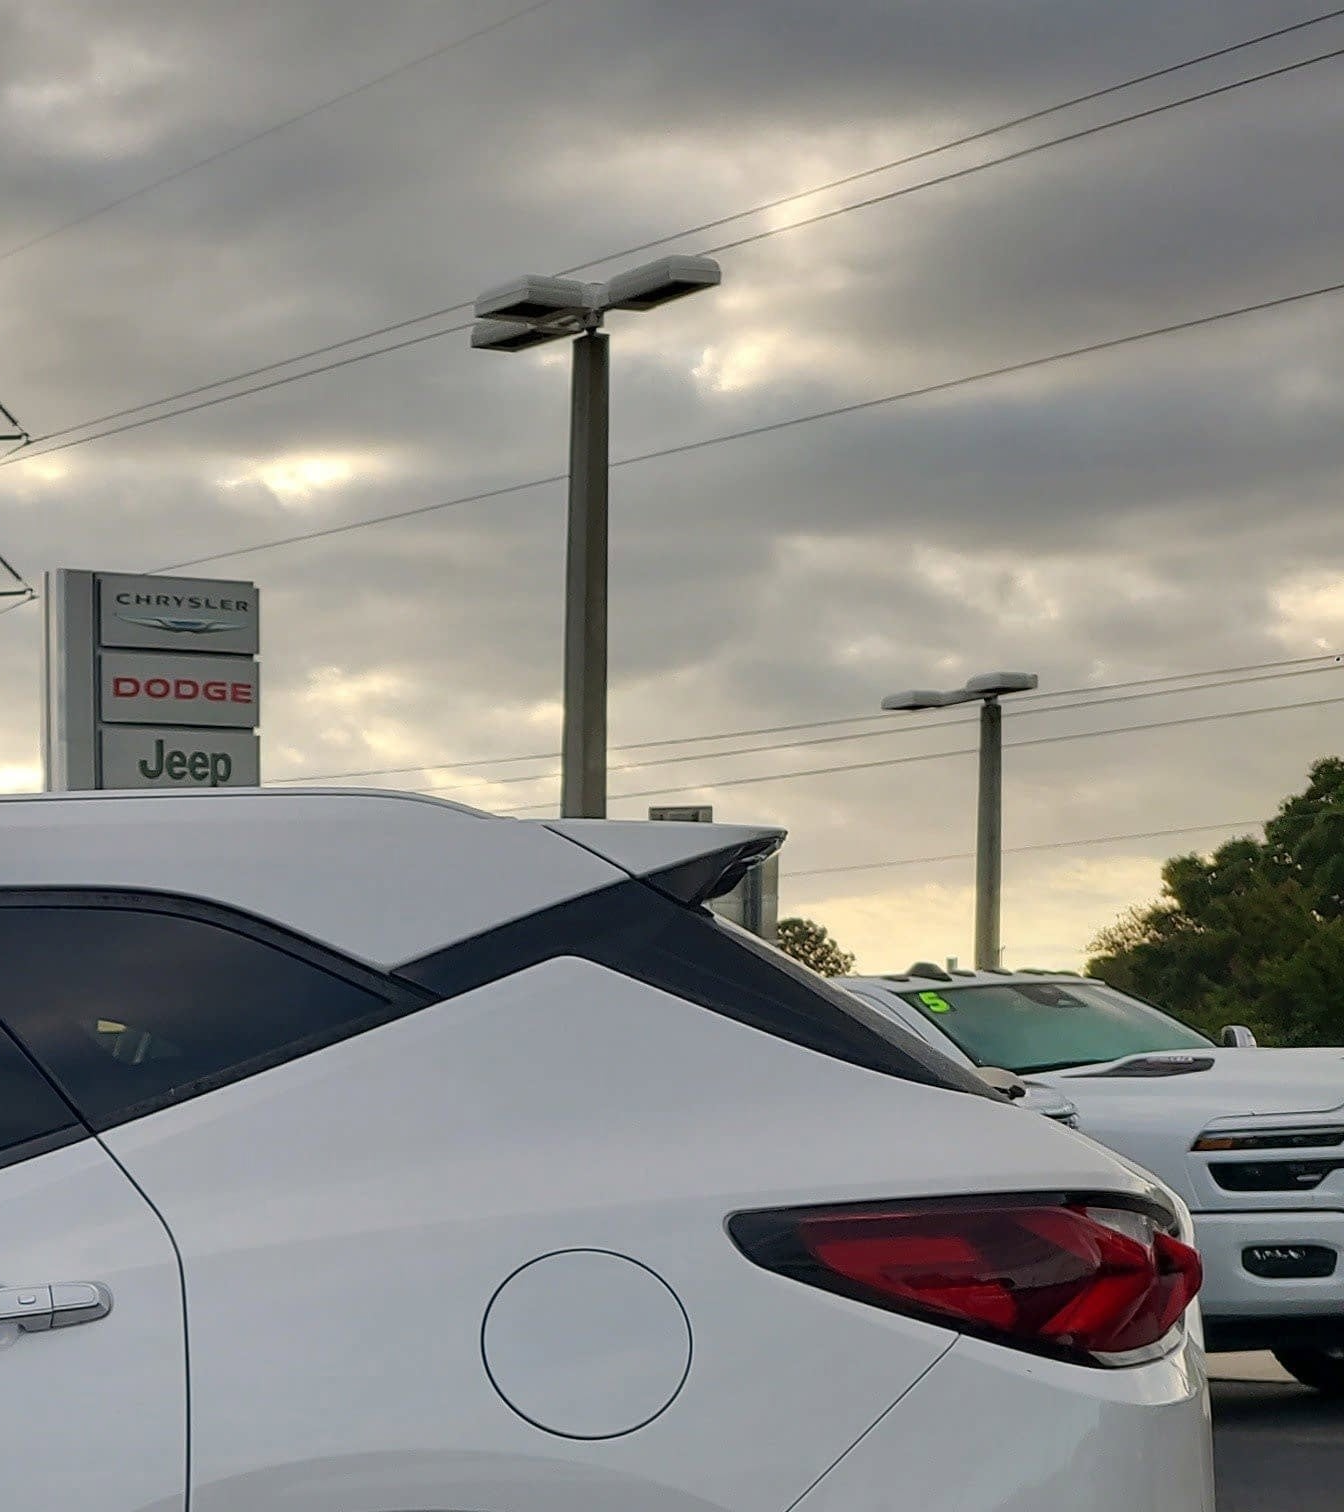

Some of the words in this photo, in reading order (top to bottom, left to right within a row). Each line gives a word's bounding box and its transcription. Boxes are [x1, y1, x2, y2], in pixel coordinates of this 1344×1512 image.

[116, 592, 249, 612] CHRYSLER
[113, 677, 253, 704] DODGE
[138, 738, 232, 788] Jeep
[918, 991, 950, 1013] 5
